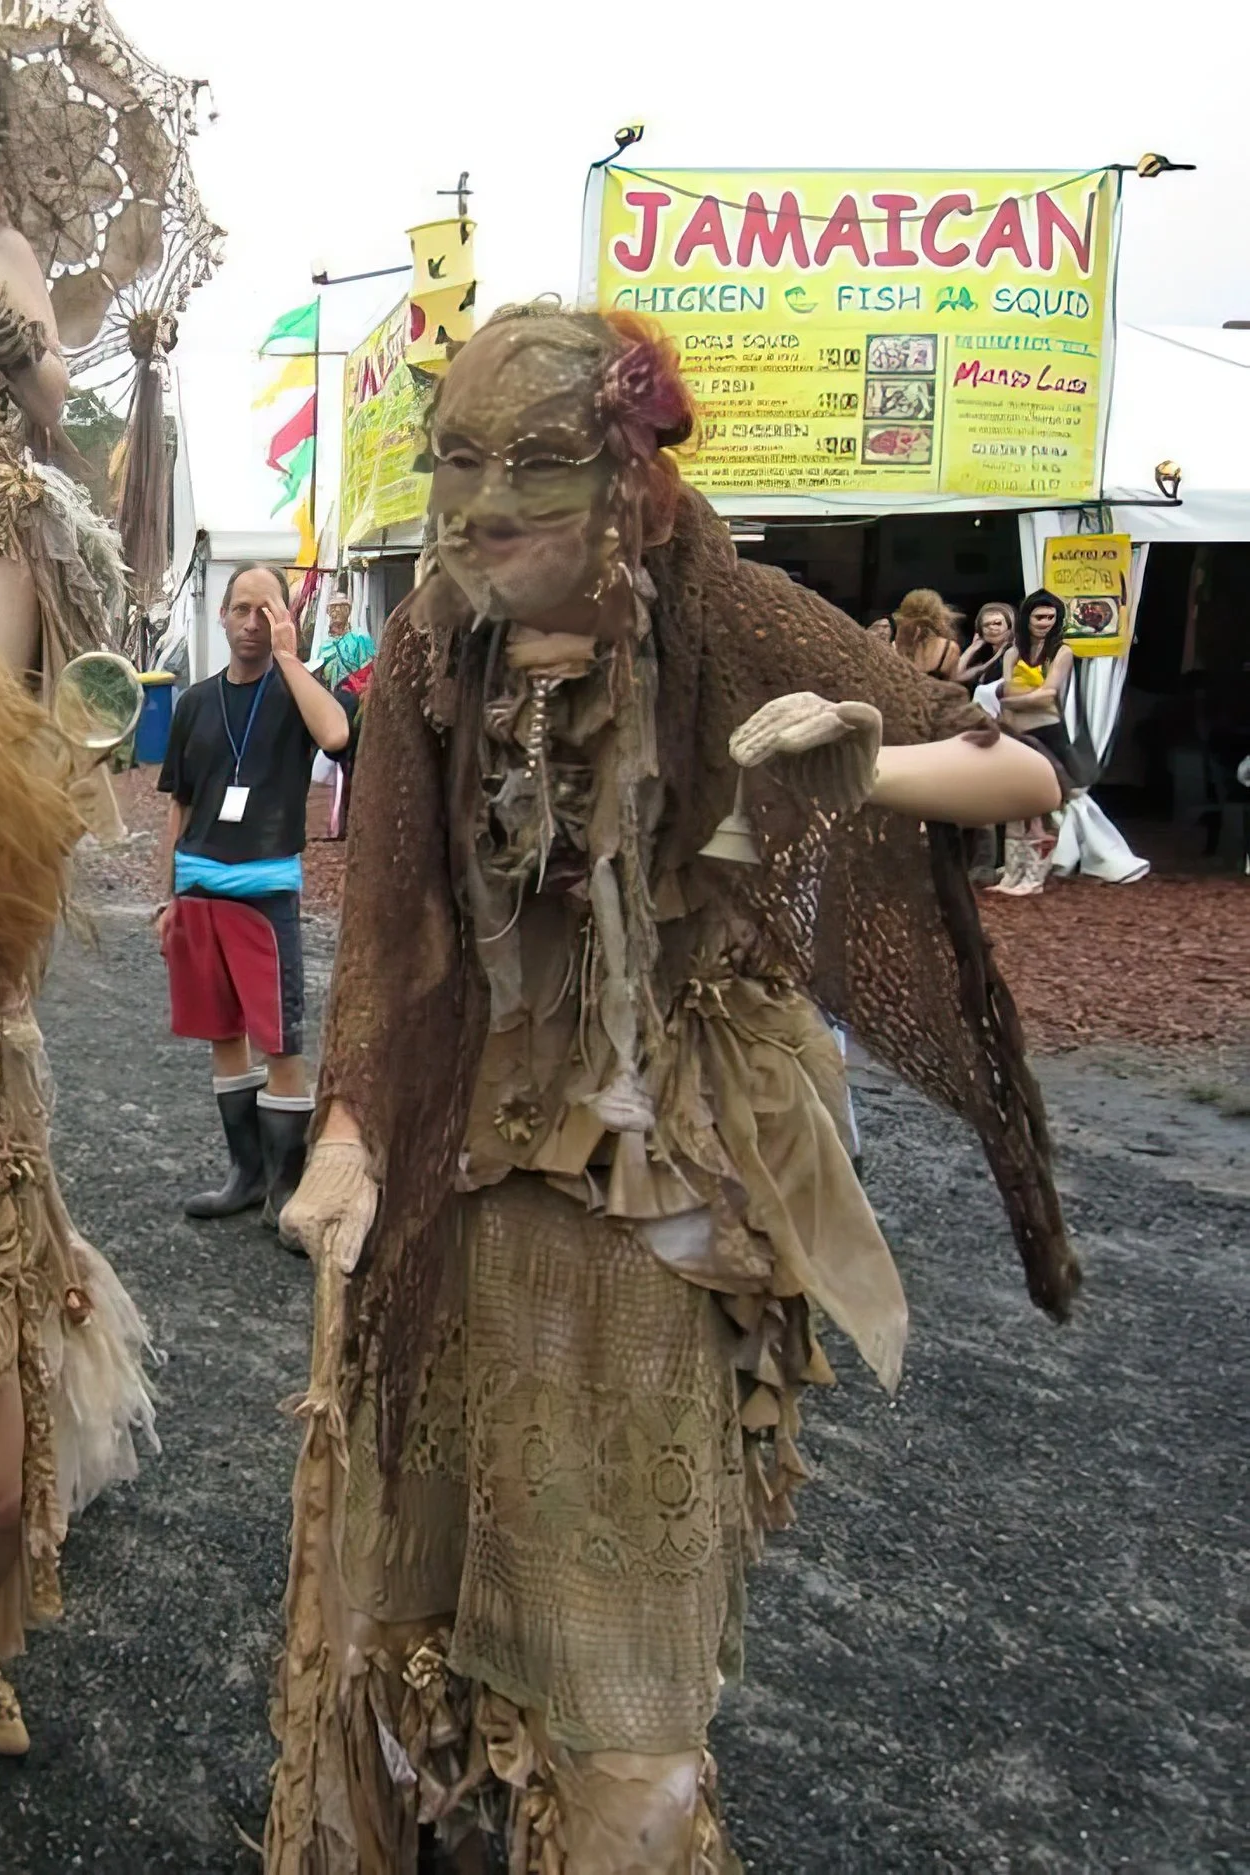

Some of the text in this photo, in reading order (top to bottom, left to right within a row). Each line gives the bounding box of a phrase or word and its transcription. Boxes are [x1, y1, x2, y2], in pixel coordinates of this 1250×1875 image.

[614, 190, 1096, 273] JAMAICAN
[614, 285, 1091, 319] CHICKEN FISH SQUID
